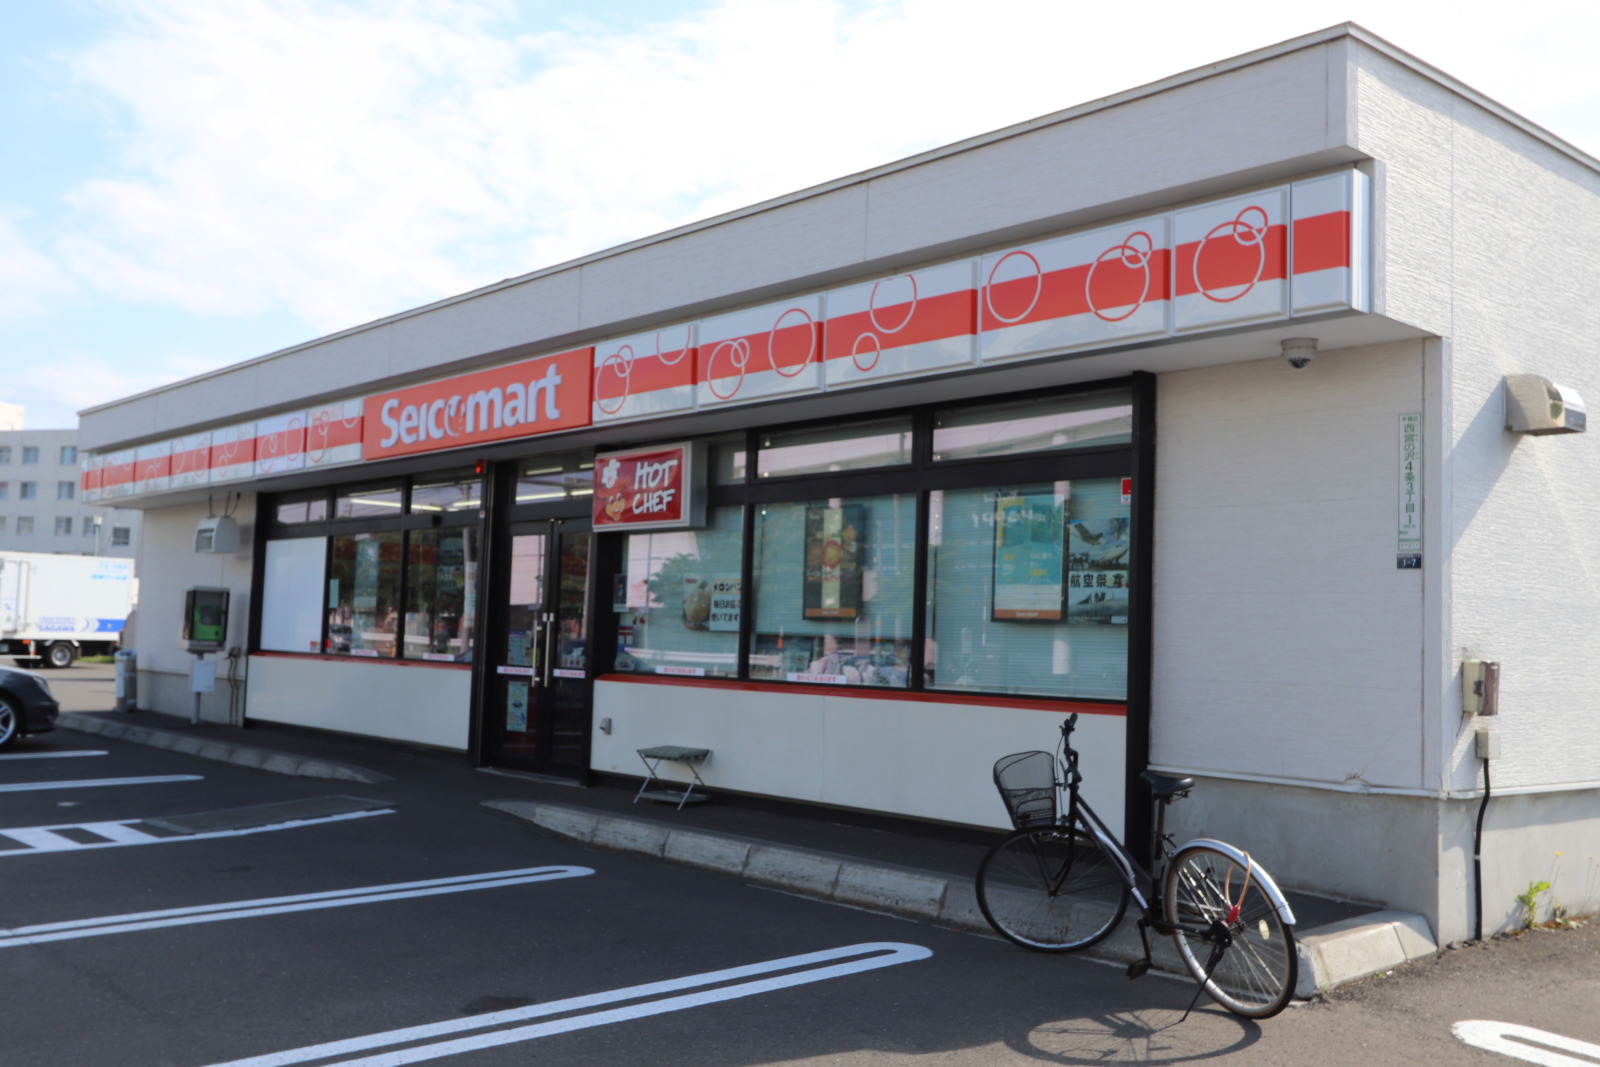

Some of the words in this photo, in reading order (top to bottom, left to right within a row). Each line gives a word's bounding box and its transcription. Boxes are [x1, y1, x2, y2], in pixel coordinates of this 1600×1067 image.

[380, 363, 562, 448] Seicomart
[634, 459, 678, 490] HOT
[632, 488, 675, 514] CHEF
[1071, 573, 1107, 588] 航空祭
